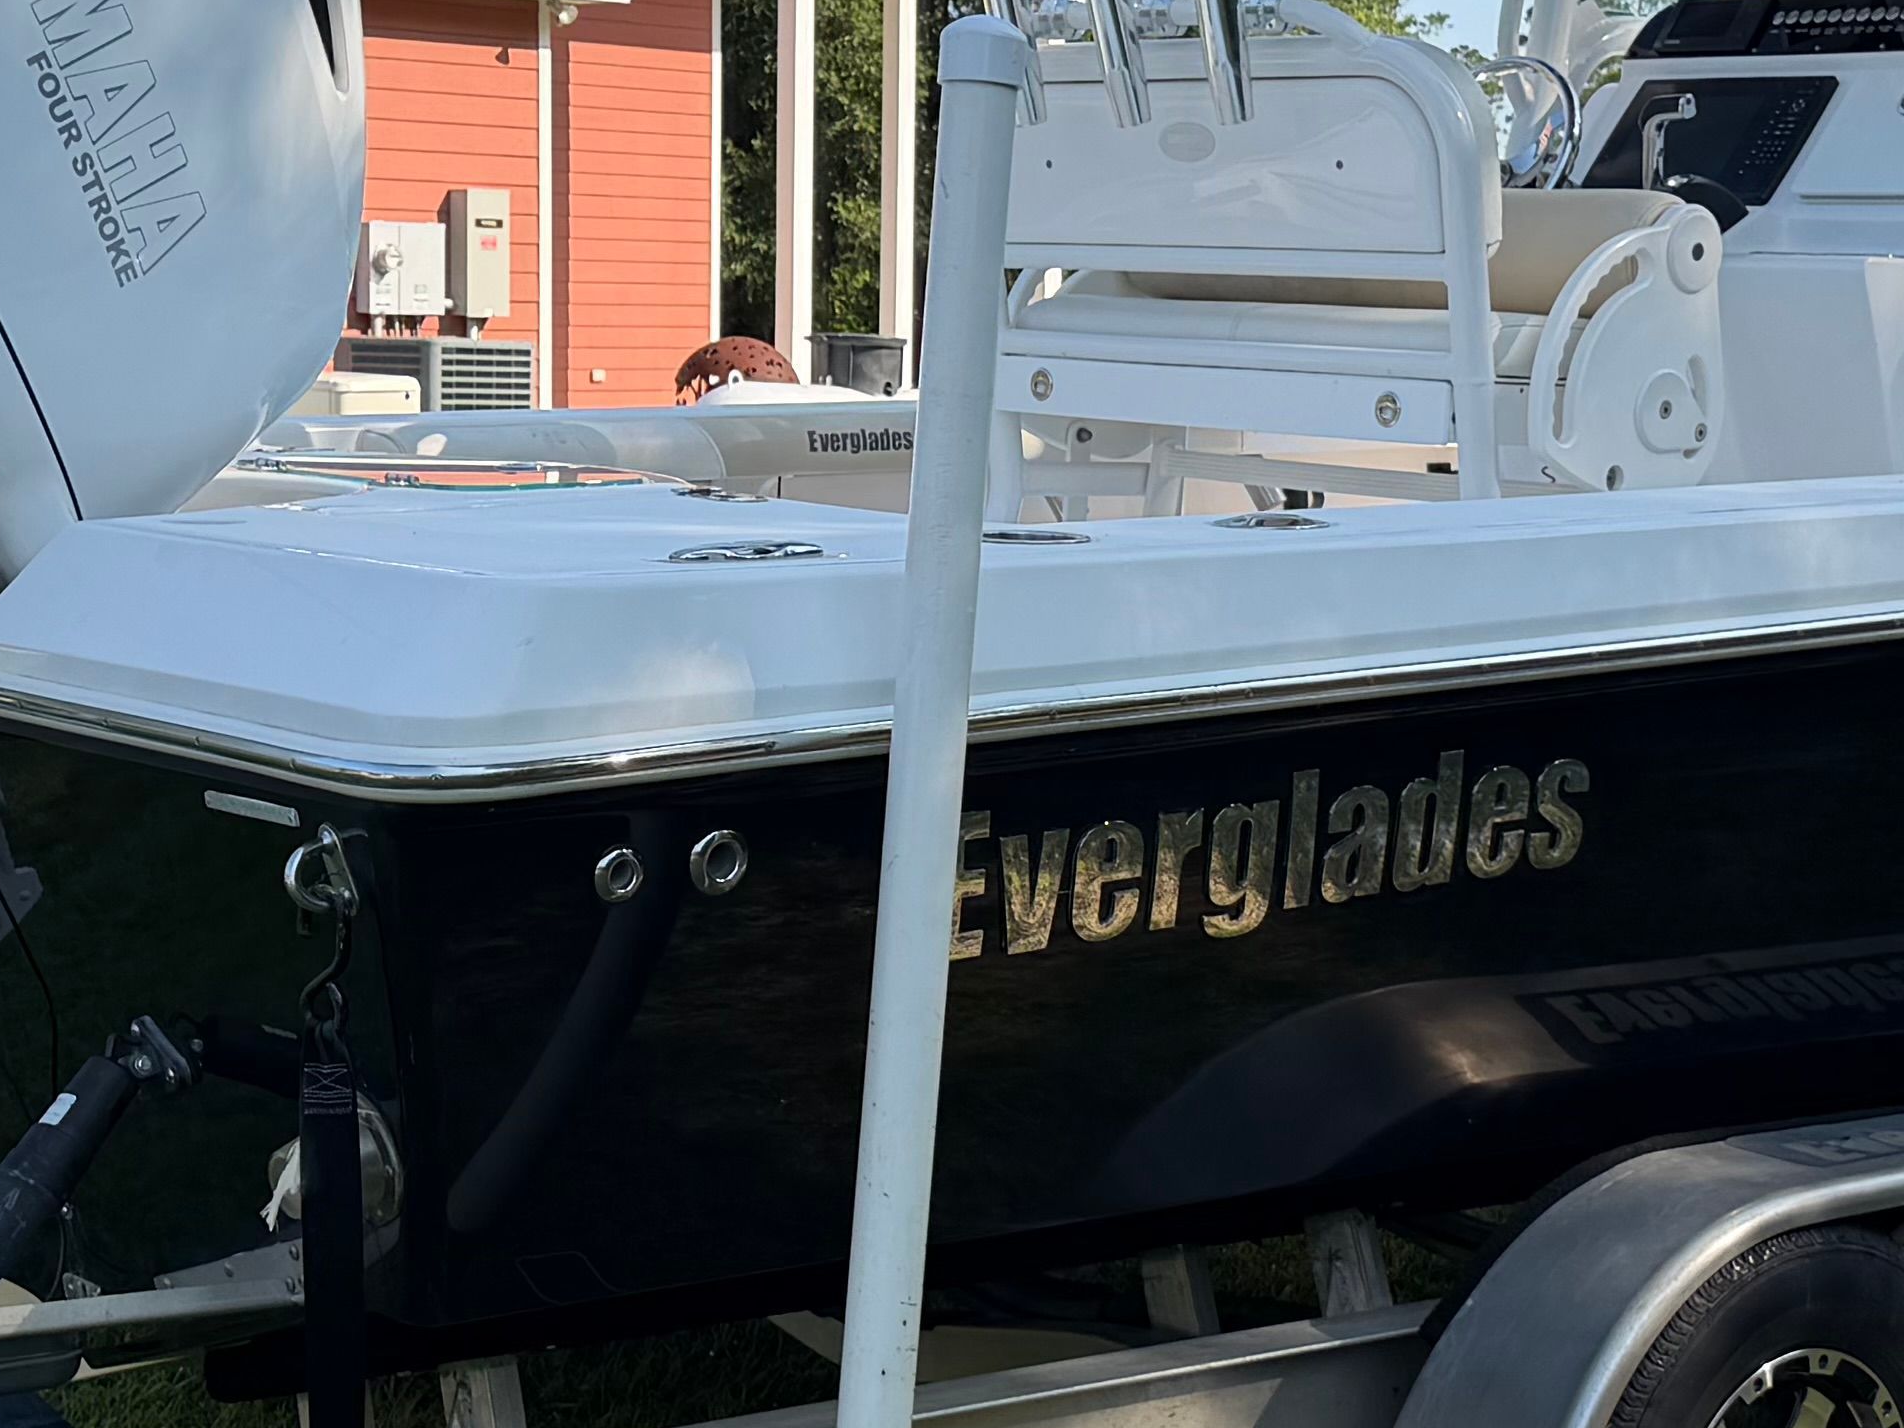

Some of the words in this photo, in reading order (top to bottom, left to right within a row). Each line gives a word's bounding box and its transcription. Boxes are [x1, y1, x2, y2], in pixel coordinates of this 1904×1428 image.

[25, 48, 83, 148] FOUR
[71, 154, 139, 289] STROKE
[807, 428, 914, 454] Everglades
[948, 747, 1592, 962] Everglades
